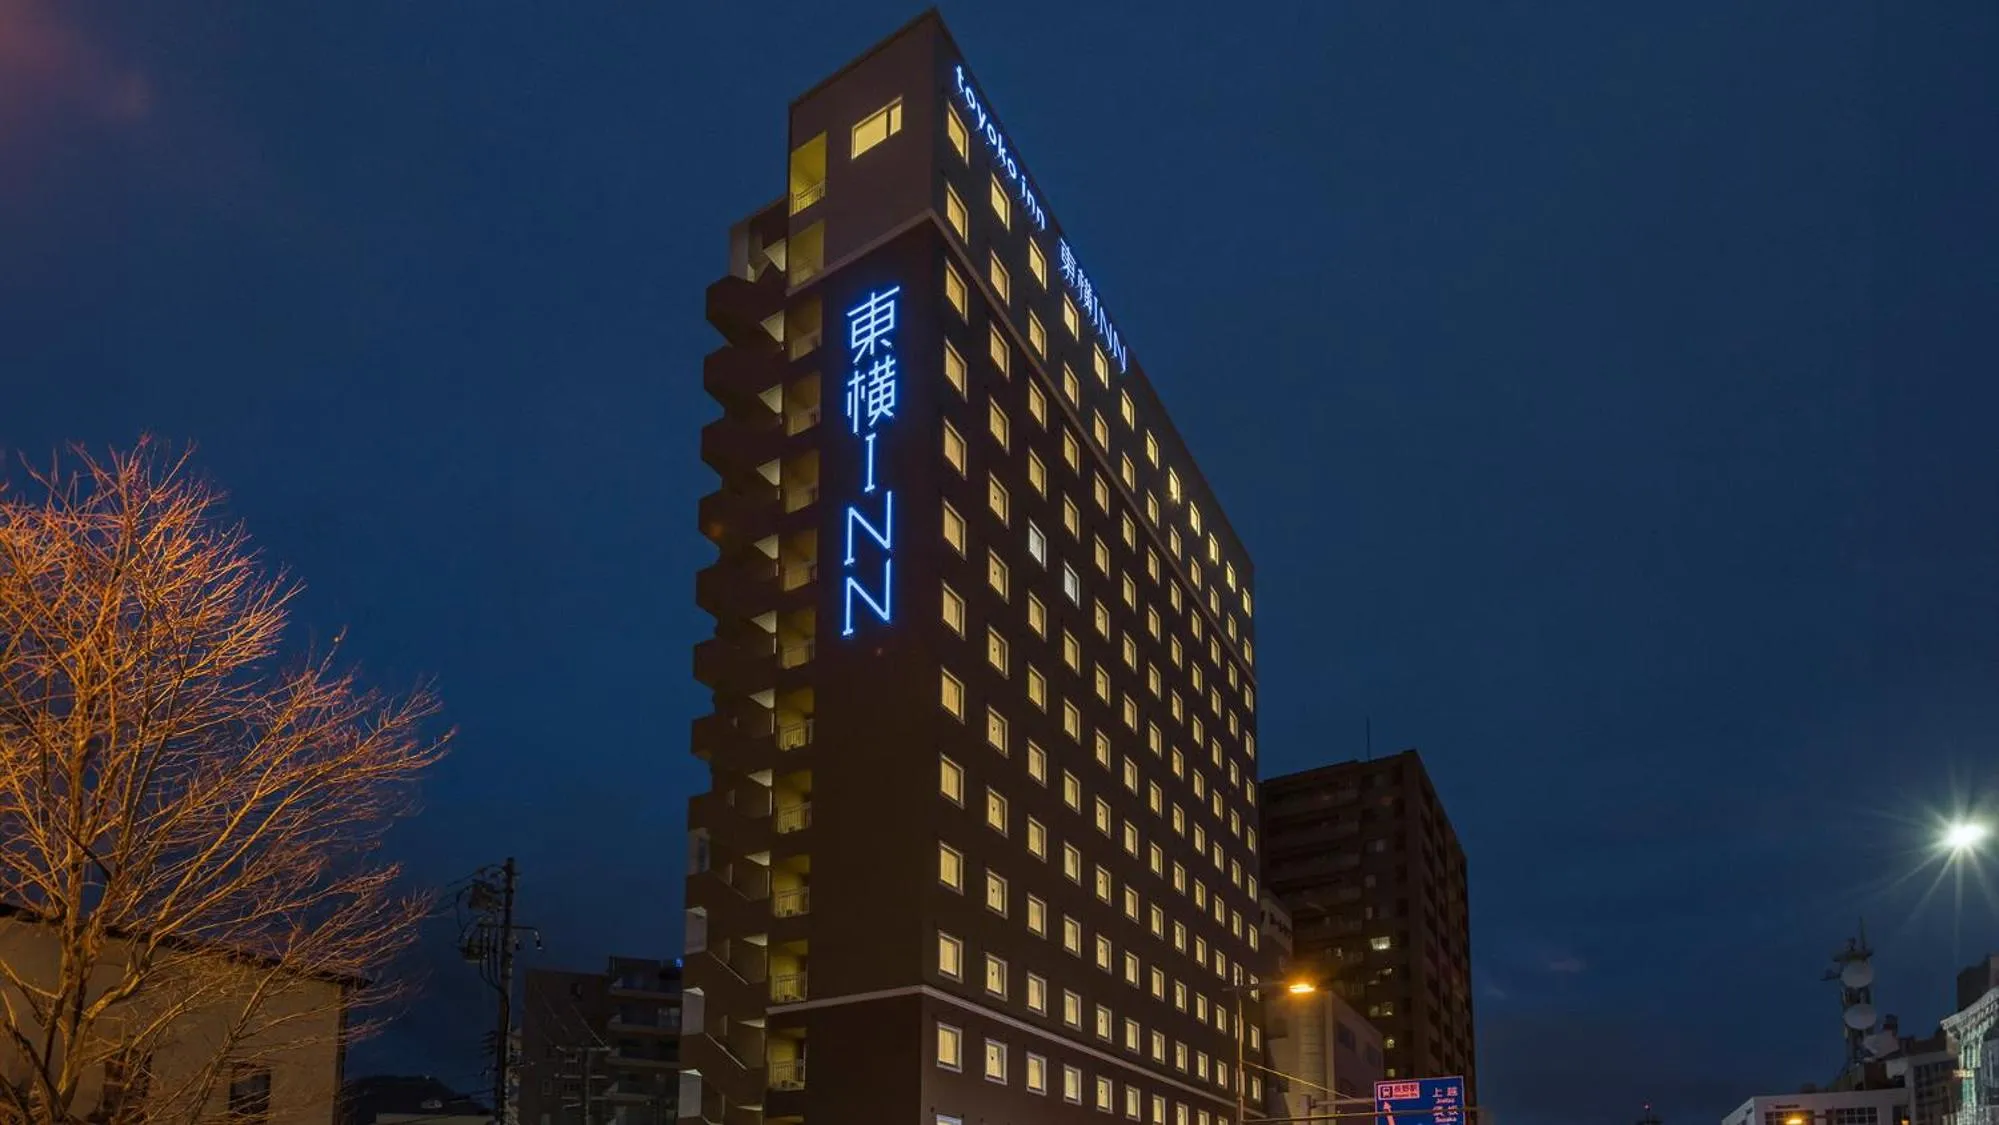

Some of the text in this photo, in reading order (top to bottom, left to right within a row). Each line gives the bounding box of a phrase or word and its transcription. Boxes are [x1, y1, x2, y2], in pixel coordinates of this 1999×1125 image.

[955, 64, 1046, 231] toyoko inn
[843, 286, 900, 636] 東横INN
